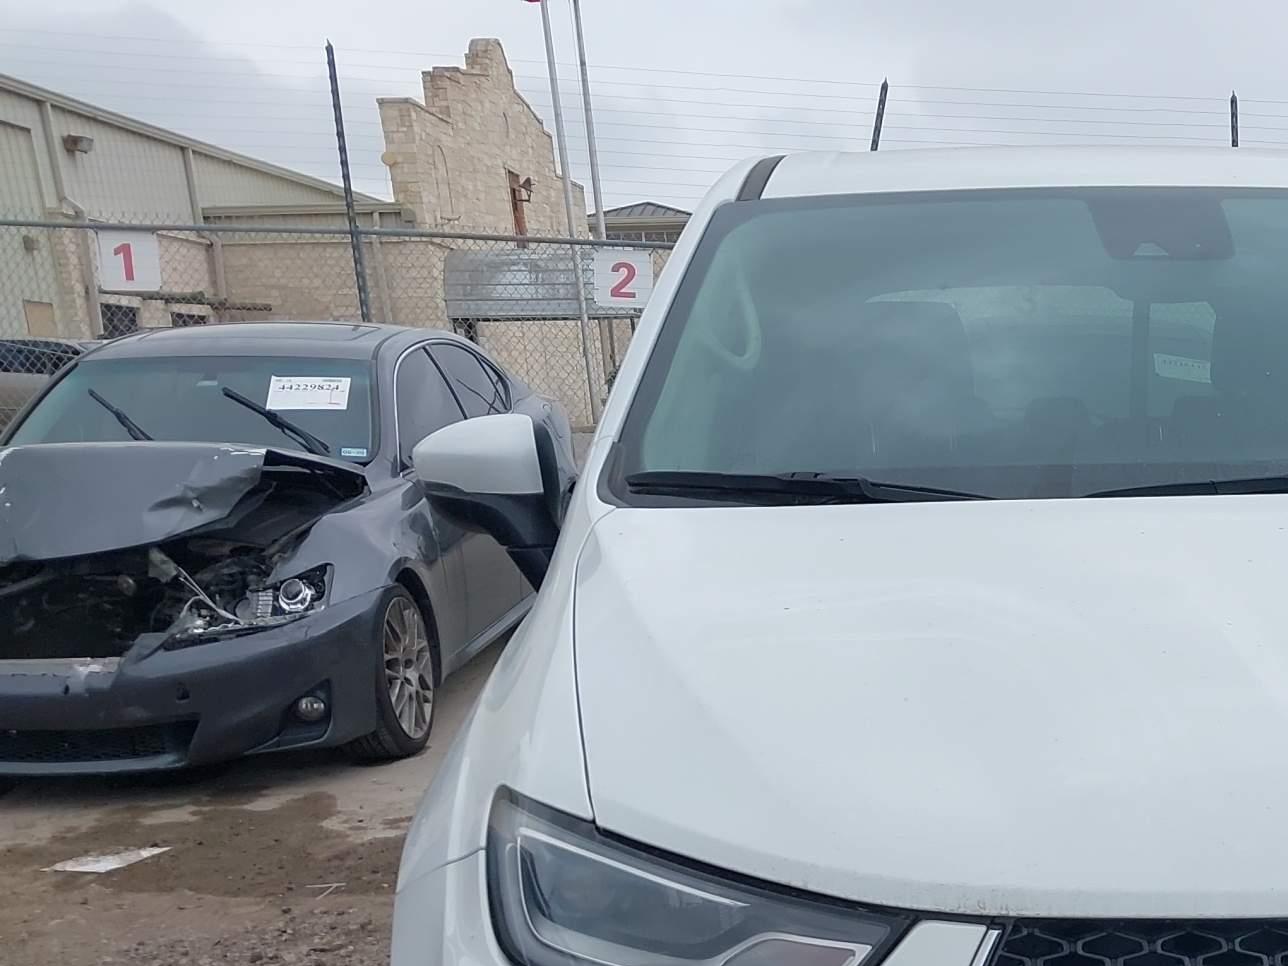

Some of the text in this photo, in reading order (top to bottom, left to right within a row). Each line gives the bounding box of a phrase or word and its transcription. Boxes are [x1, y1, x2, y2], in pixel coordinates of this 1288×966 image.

[113, 243, 135, 281] 1
[610, 261, 637, 299] 2
[278, 383, 340, 391] 44229824
